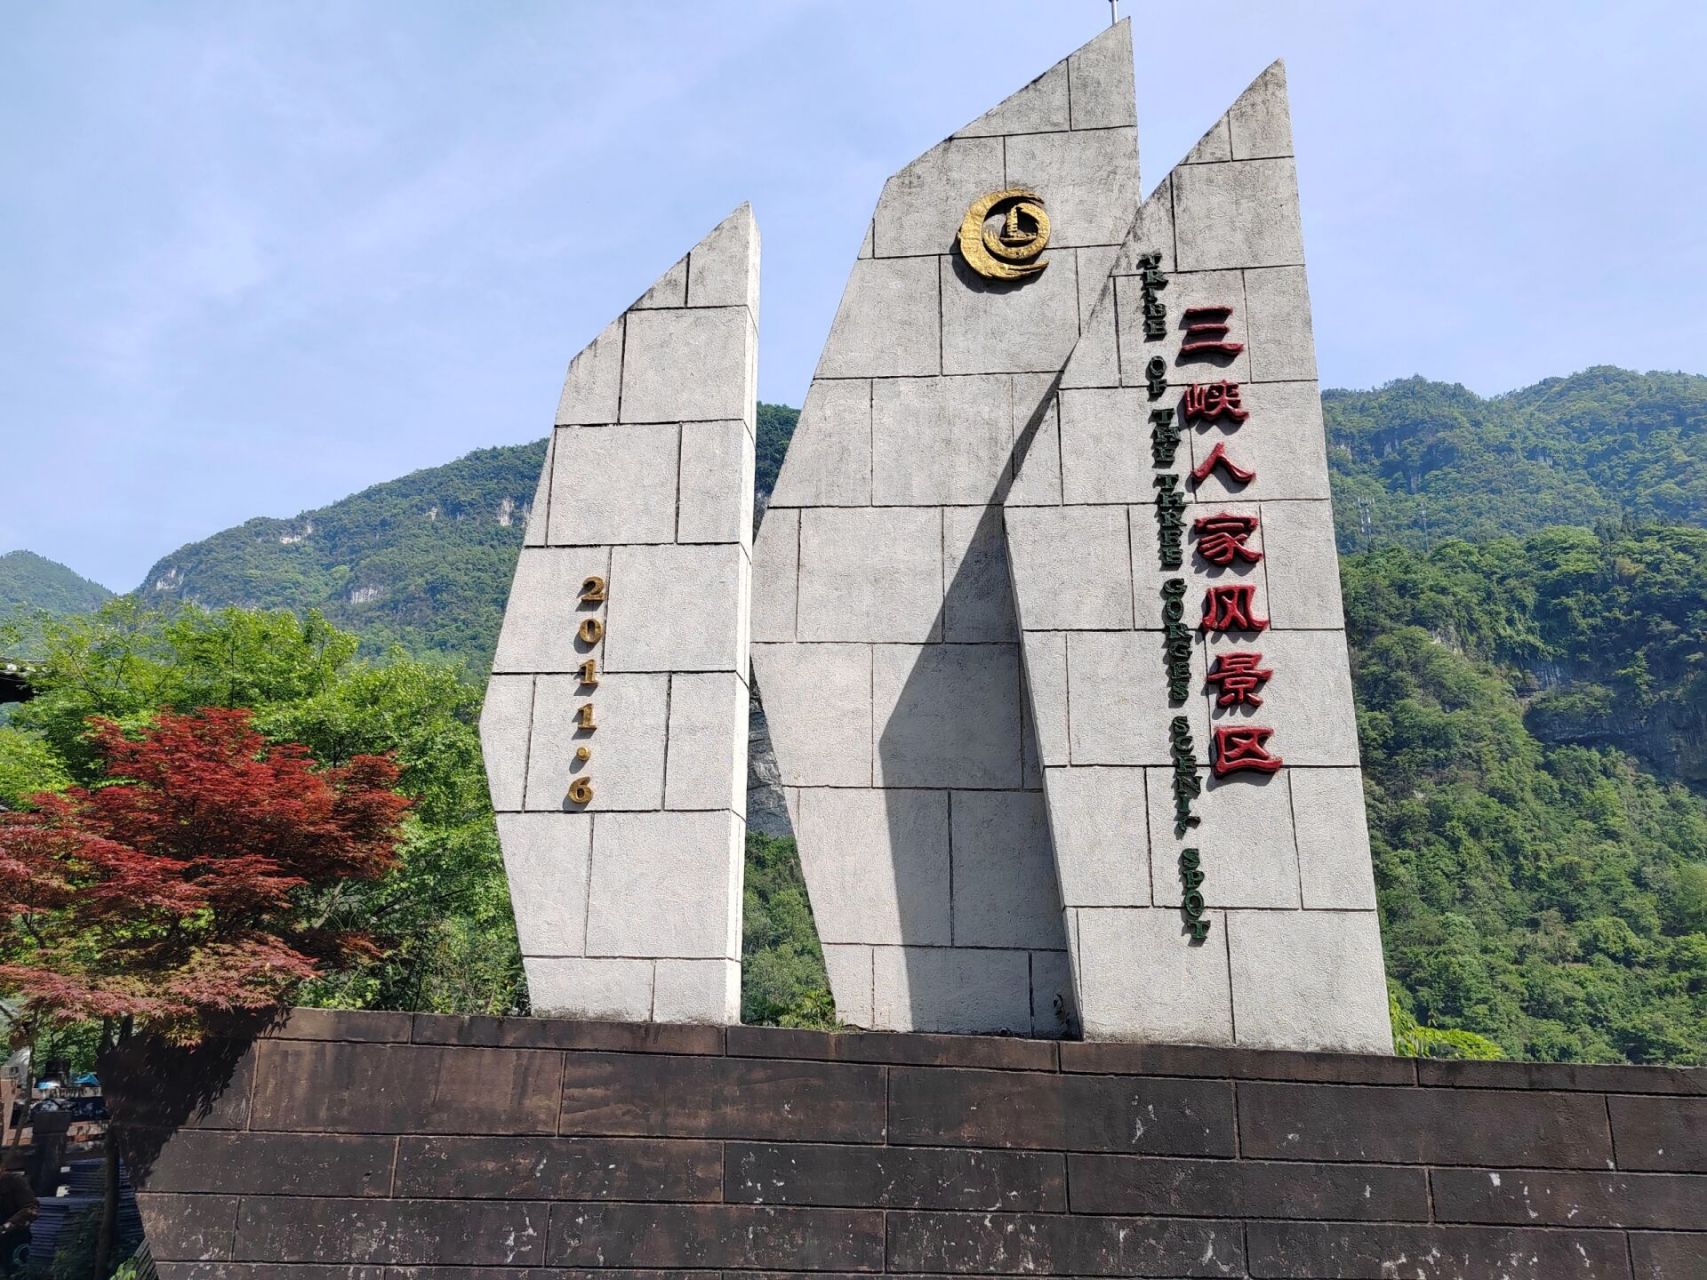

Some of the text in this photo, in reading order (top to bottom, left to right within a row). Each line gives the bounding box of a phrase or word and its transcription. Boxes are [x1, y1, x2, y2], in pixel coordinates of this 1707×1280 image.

[1139, 253, 1168, 337] TRIBE
[1150, 355, 1167, 396] OF
[1152, 408, 1181, 463] THE
[1157, 474, 1187, 567] THREE
[1181, 307, 1283, 777] 三峡人家风景区
[1163, 578, 1193, 702] GORGES
[1182, 849, 1210, 941] SPOT
